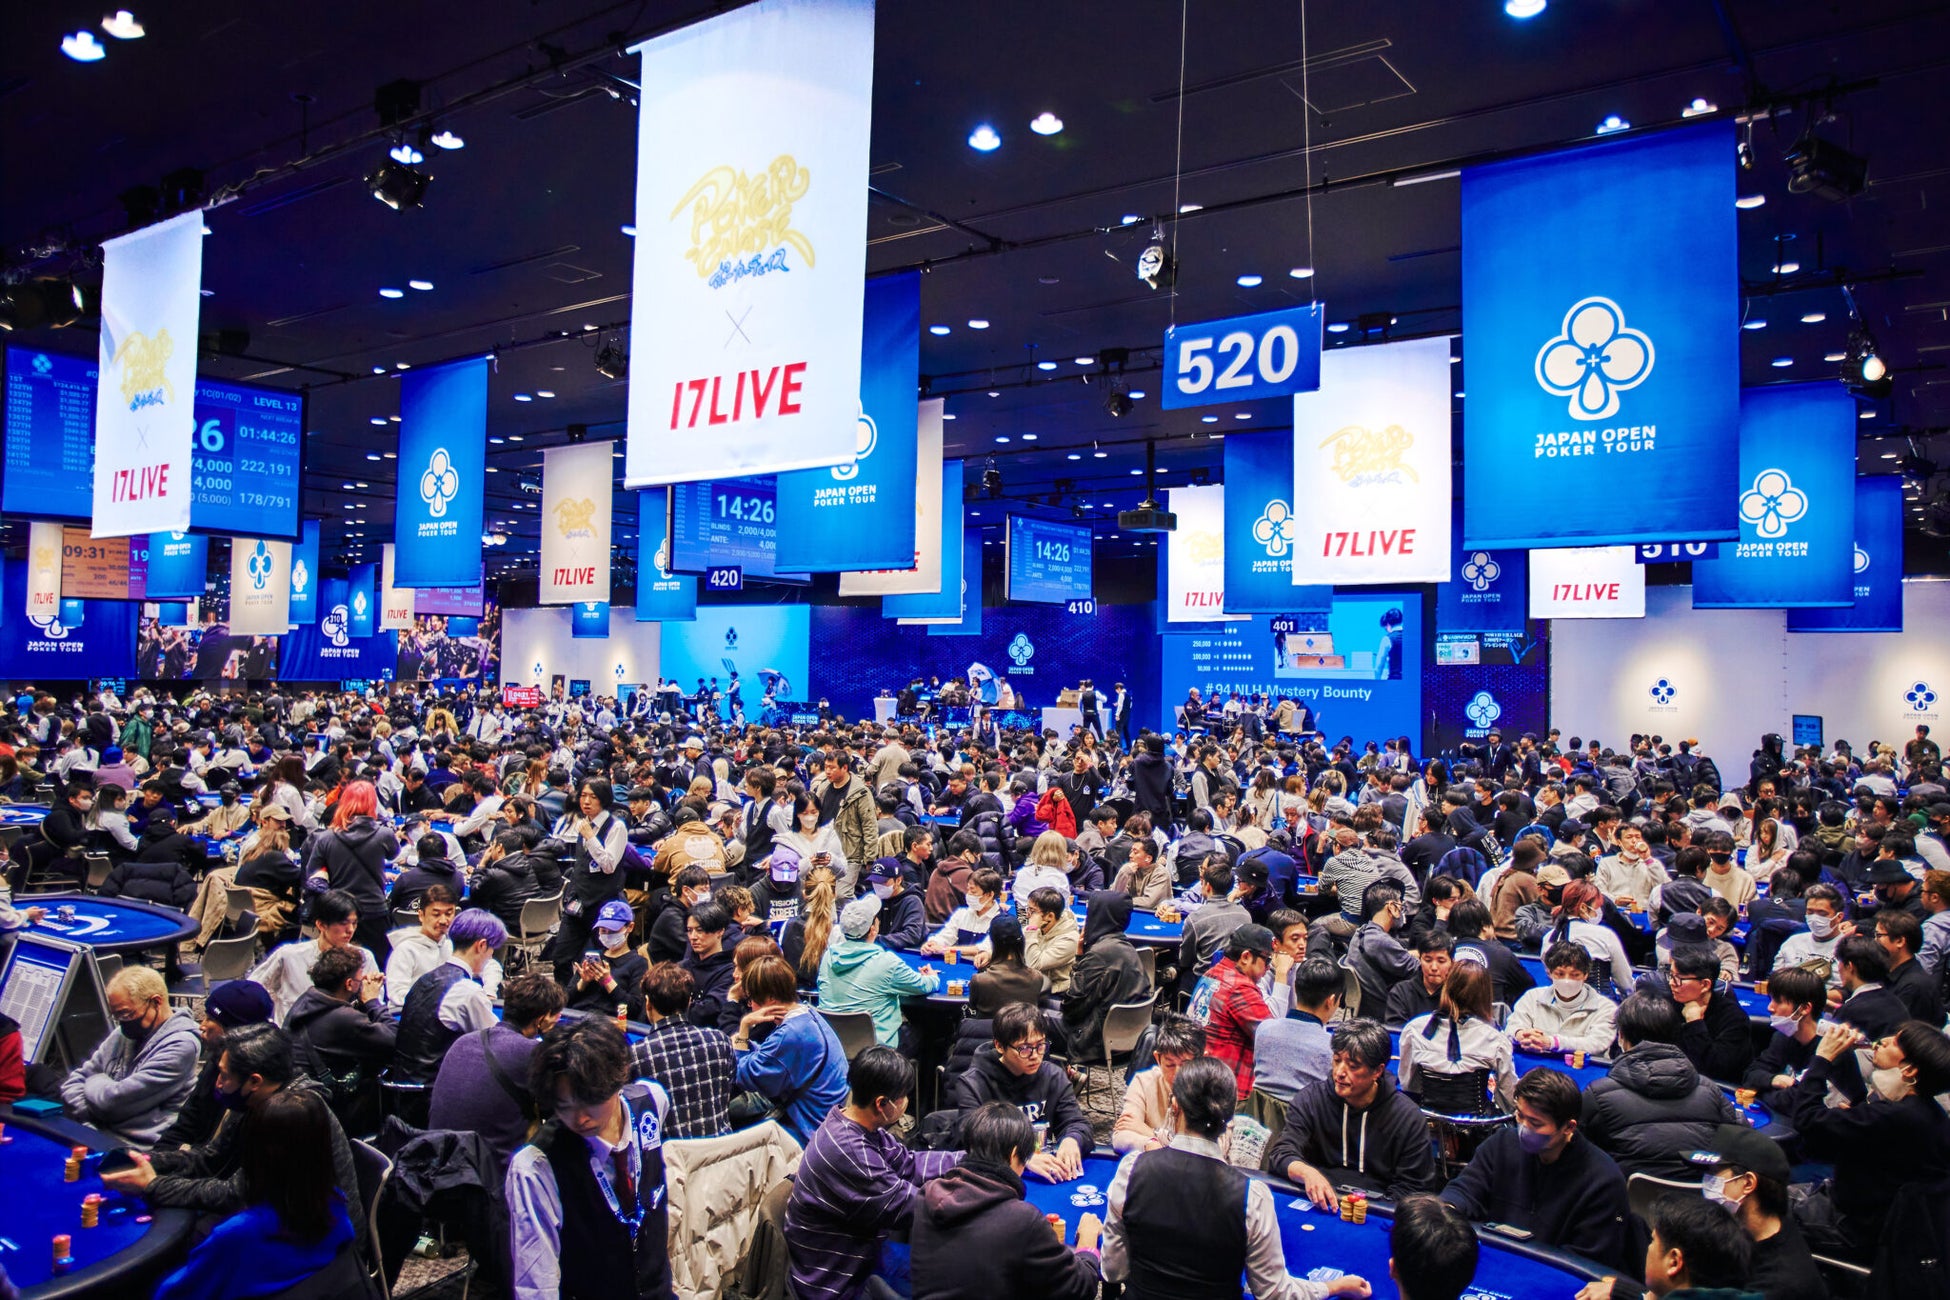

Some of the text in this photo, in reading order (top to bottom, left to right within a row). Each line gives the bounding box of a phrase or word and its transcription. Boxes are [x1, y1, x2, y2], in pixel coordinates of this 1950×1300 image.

[1177, 325, 1299, 394] 520
[254, 396, 297, 411] LEVEL 13
[670, 362, 807, 430] 17LIVE
[239, 426, 296, 445] 01:44:26
[1535, 425, 1656, 447] JAPAN OPEN
[1535, 440, 1655, 458] POKER TOUR
[241, 459, 291, 476] 222,191
[112, 464, 170, 503] 17LIVE
[194, 476, 232, 491] 4,000
[814, 484, 876, 498] JAPAN OPEN
[239, 493, 291, 508] 178/791
[717, 495, 774, 523] 14:26
[814, 495, 876, 507] POKER TOUR
[418, 521, 458, 530] JAPAN OPEN
[711, 535, 729, 544] ANTE:
[1323, 529, 1416, 557] 17LIVE
[1736, 542, 1808, 553] JAPAN OPEN
[63, 545, 105, 559] 09:31
[1036, 541, 1070, 562] 14:26
[1777, 549, 1808, 557] TOUR
[553, 567, 595, 586] 17LIVE
[711, 570, 738, 587] 420
[1552, 582, 1621, 601] 17LIVE
[1068, 601, 1093, 614] 410
[1273, 621, 1294, 632] 401
[1235, 684, 1262, 696] NLH
[1266, 685, 1319, 699] Mystery
[1323, 686, 1372, 702] Bounty
[769, 908, 799, 918] STREET
